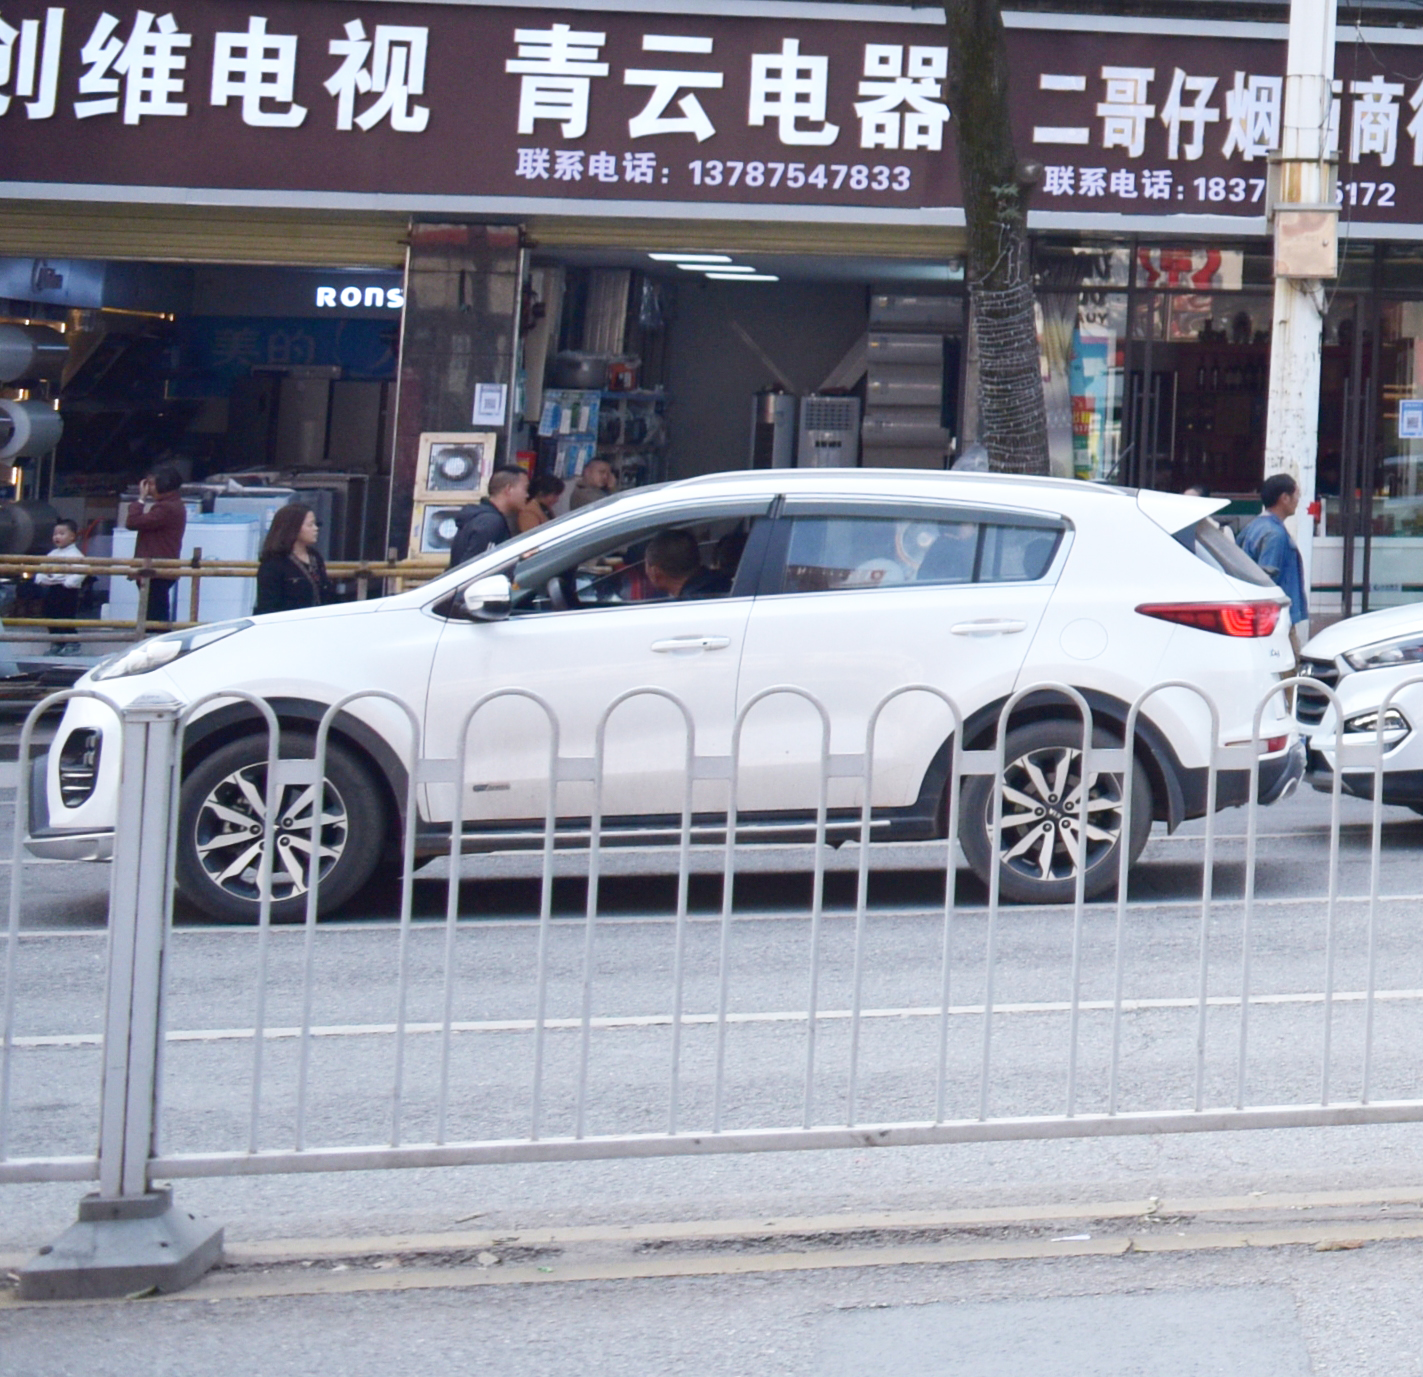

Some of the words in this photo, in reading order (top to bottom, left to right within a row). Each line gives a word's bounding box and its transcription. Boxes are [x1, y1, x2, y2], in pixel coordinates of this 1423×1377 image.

[0, 7, 430, 132] 创维电视
[505, 24, 950, 152] 青云电器
